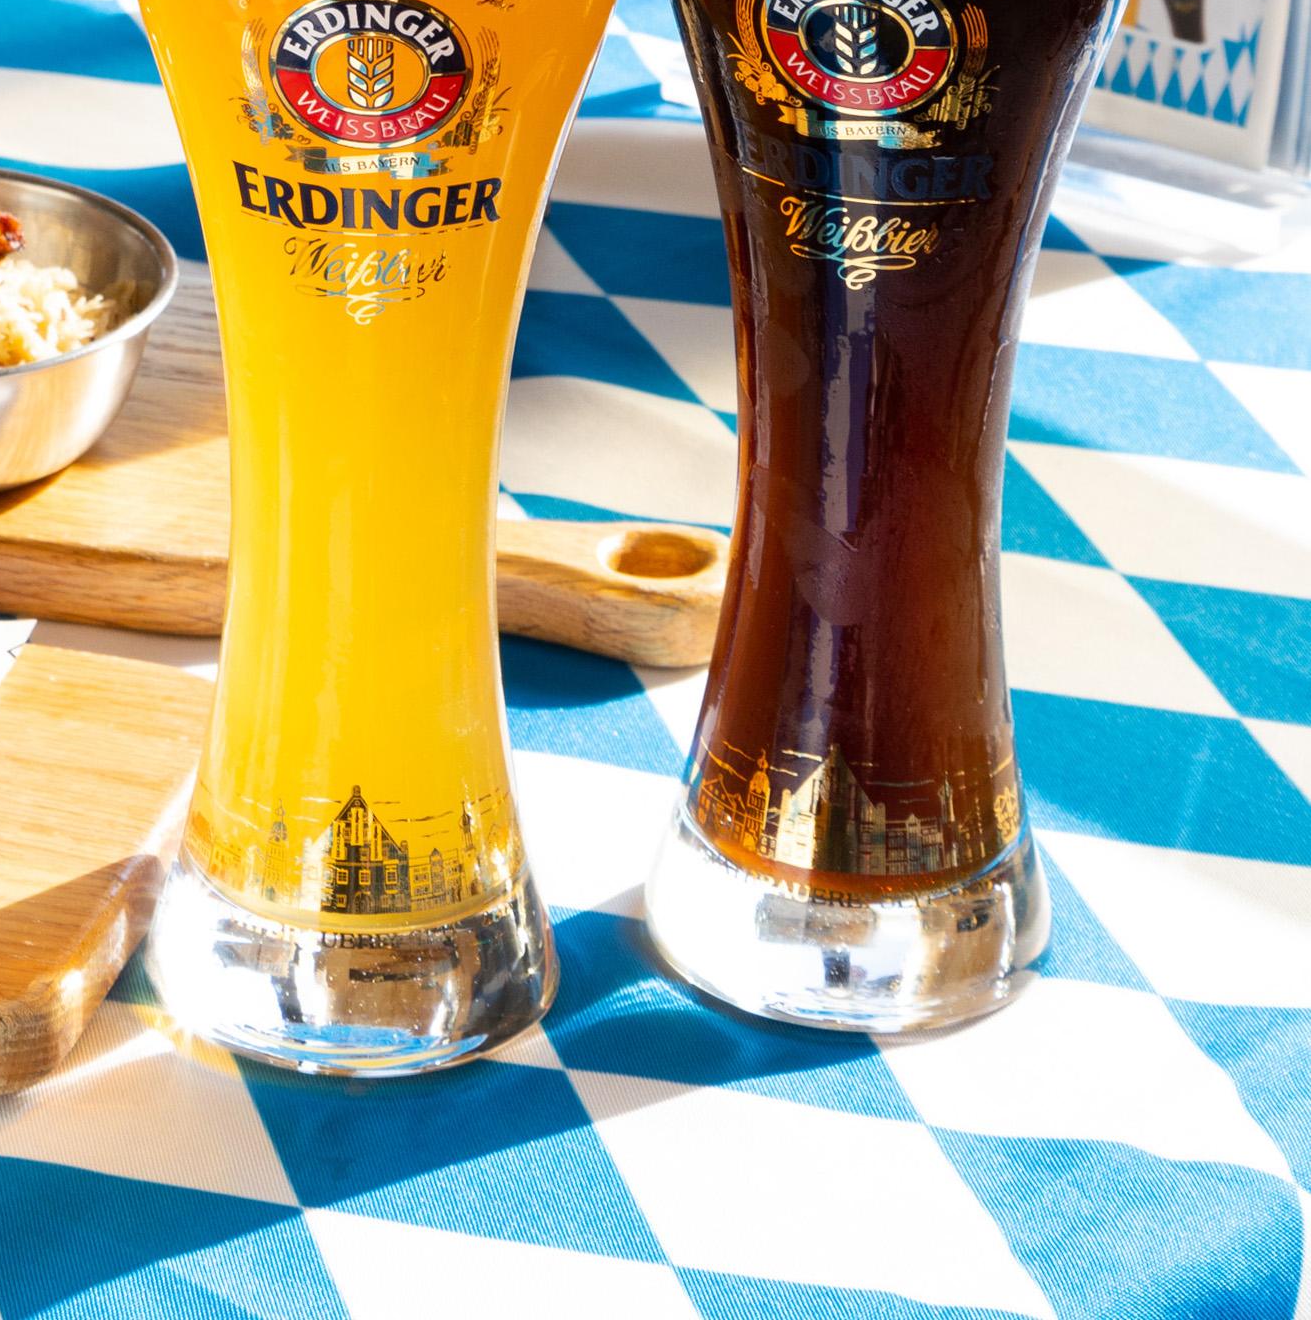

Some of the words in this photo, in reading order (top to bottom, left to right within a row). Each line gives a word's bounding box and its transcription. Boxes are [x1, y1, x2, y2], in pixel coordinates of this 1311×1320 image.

[282, 3, 456, 65] ERDINGER
[786, 50, 936, 108] WEISSBRÄU
[296, 88, 452, 140] WEISSBRÄU
[844, 125, 908, 137] BAYERN
[356, 156, 422, 171] BAYERN
[737, 117, 995, 201] ERDINGER
[232, 160, 503, 232] ERDINGER
[779, 196, 940, 259] Weißbier
